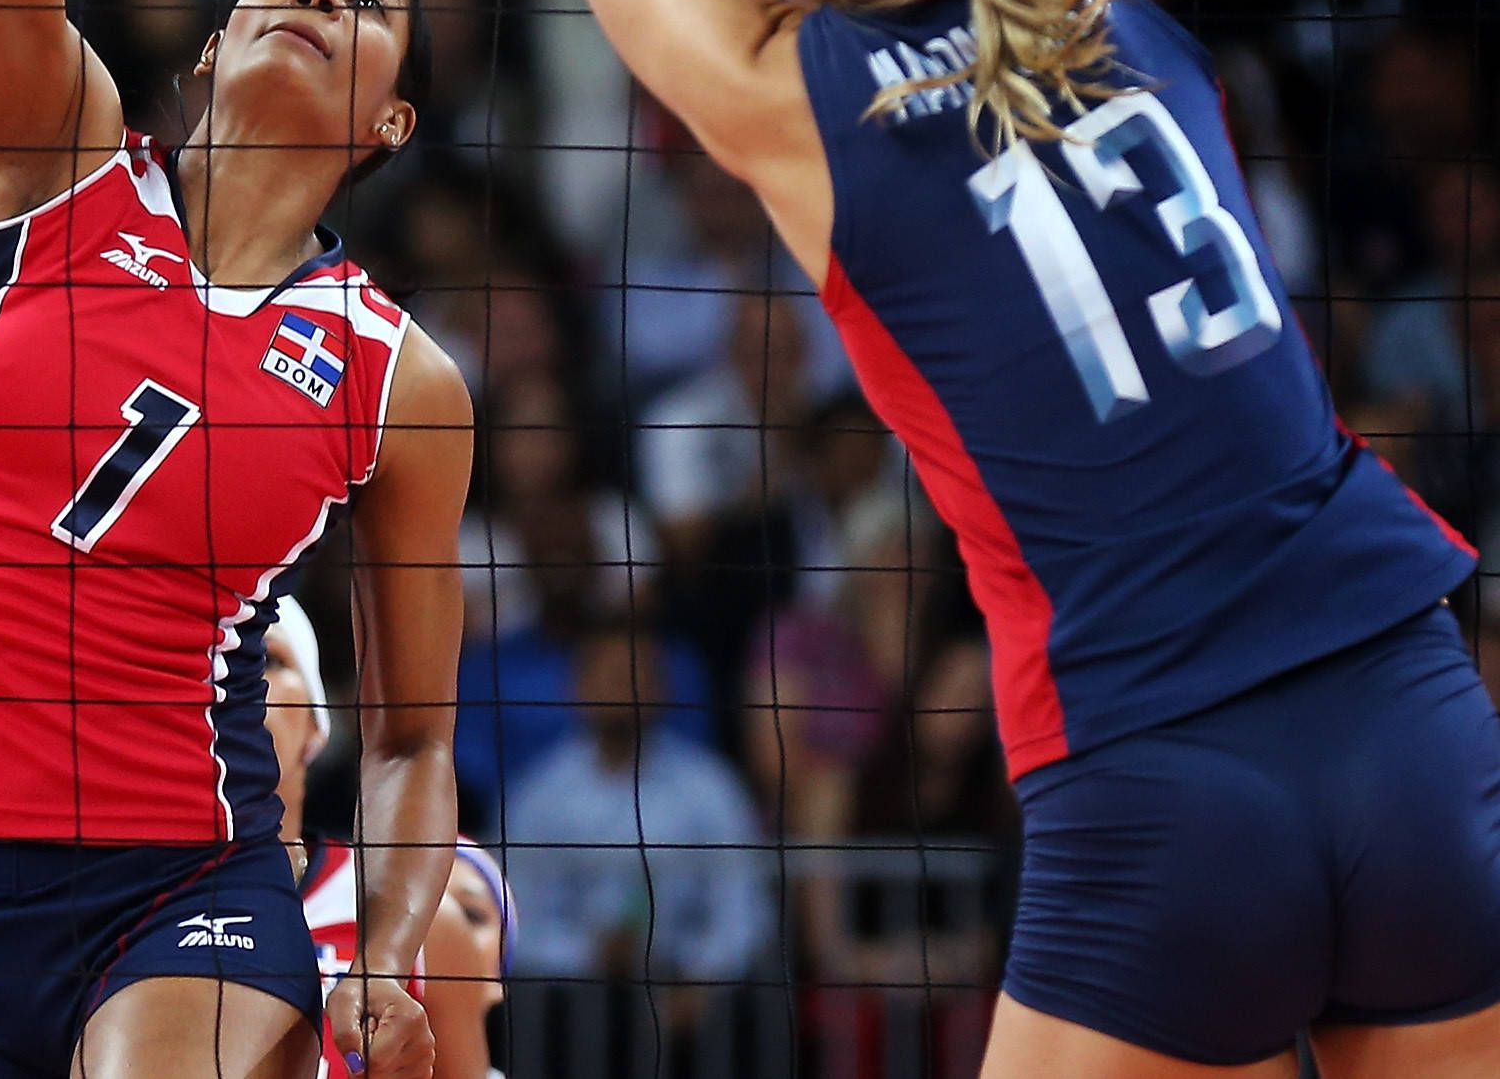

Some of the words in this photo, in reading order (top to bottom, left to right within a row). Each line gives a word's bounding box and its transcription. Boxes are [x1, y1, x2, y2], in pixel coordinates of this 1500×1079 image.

[967, 87, 1282, 424] 13
[50, 377, 203, 554] 1
[274, 356, 324, 399] DOM
